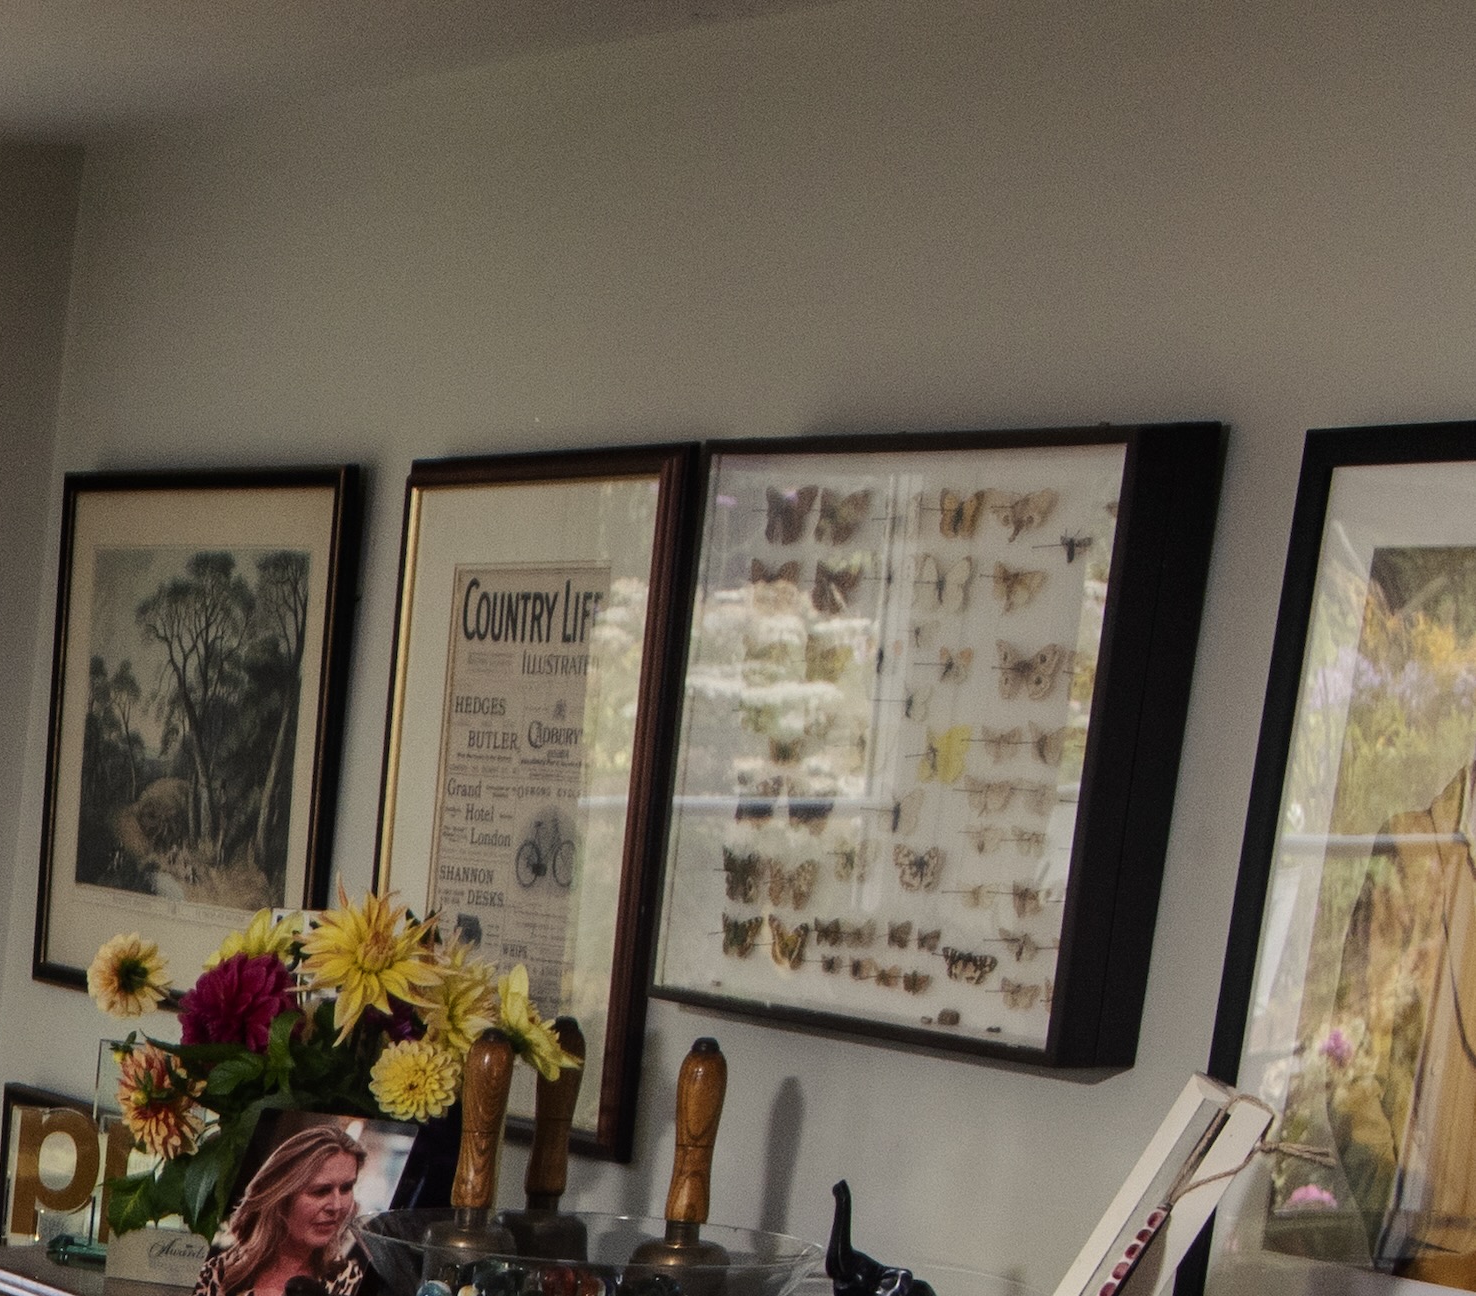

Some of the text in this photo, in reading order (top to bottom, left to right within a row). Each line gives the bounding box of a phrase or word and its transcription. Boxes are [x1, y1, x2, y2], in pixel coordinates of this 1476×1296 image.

[463, 577, 558, 643] COUNTRY
[454, 696, 507, 717] HEDGES
[470, 827, 512, 848] London
